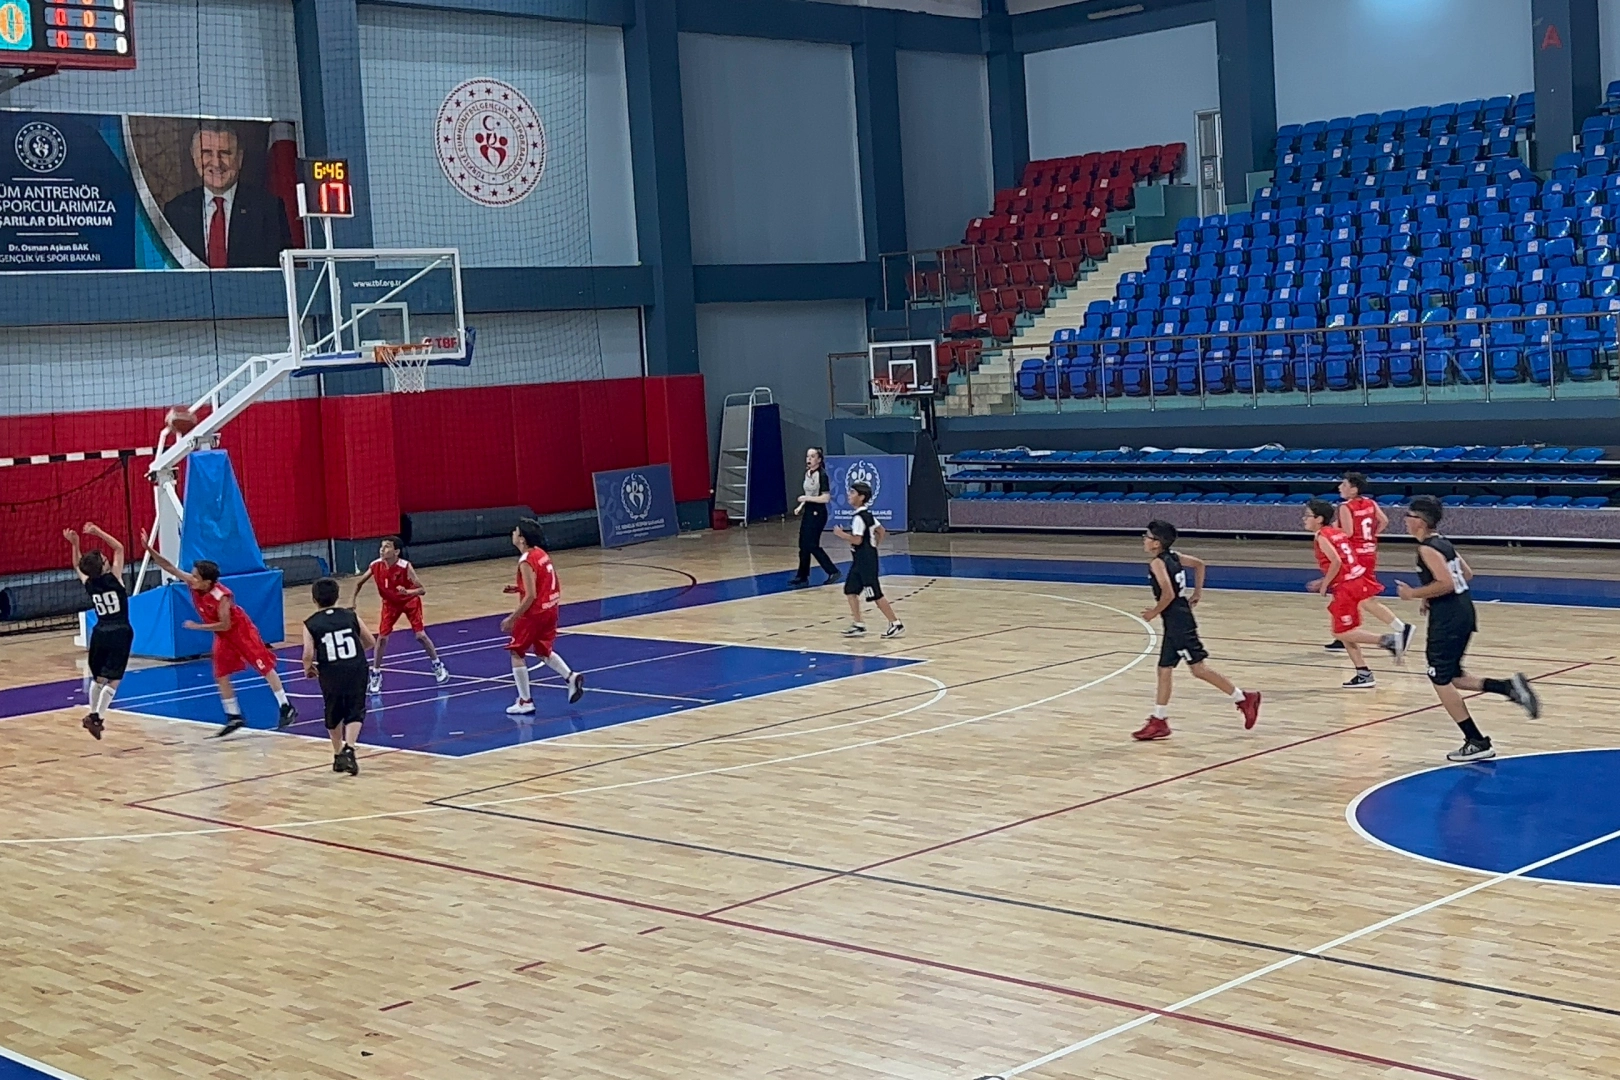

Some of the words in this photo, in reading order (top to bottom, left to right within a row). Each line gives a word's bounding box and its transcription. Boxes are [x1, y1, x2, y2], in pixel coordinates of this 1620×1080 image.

[1541, 24, 1563, 49] A
[314, 162, 344, 180] 6:46
[24, 184, 100, 199] ANTRENÖR
[321, 182, 345, 213] 17
[48, 214, 113, 227] DİLİYORUM
[8, 244, 21, 252] Dr.
[21, 244, 49, 252] Osman
[72, 244, 90, 252] BAK
[35, 254, 46, 262] VE
[46, 254, 69, 262] SPOR
[70, 254, 101, 262] BAKANI
[352, 279, 402, 288] www.tbf.org.tr
[435, 337, 458, 349] TBF
[92, 591, 121, 616] 69
[321, 628, 357, 662] 15
